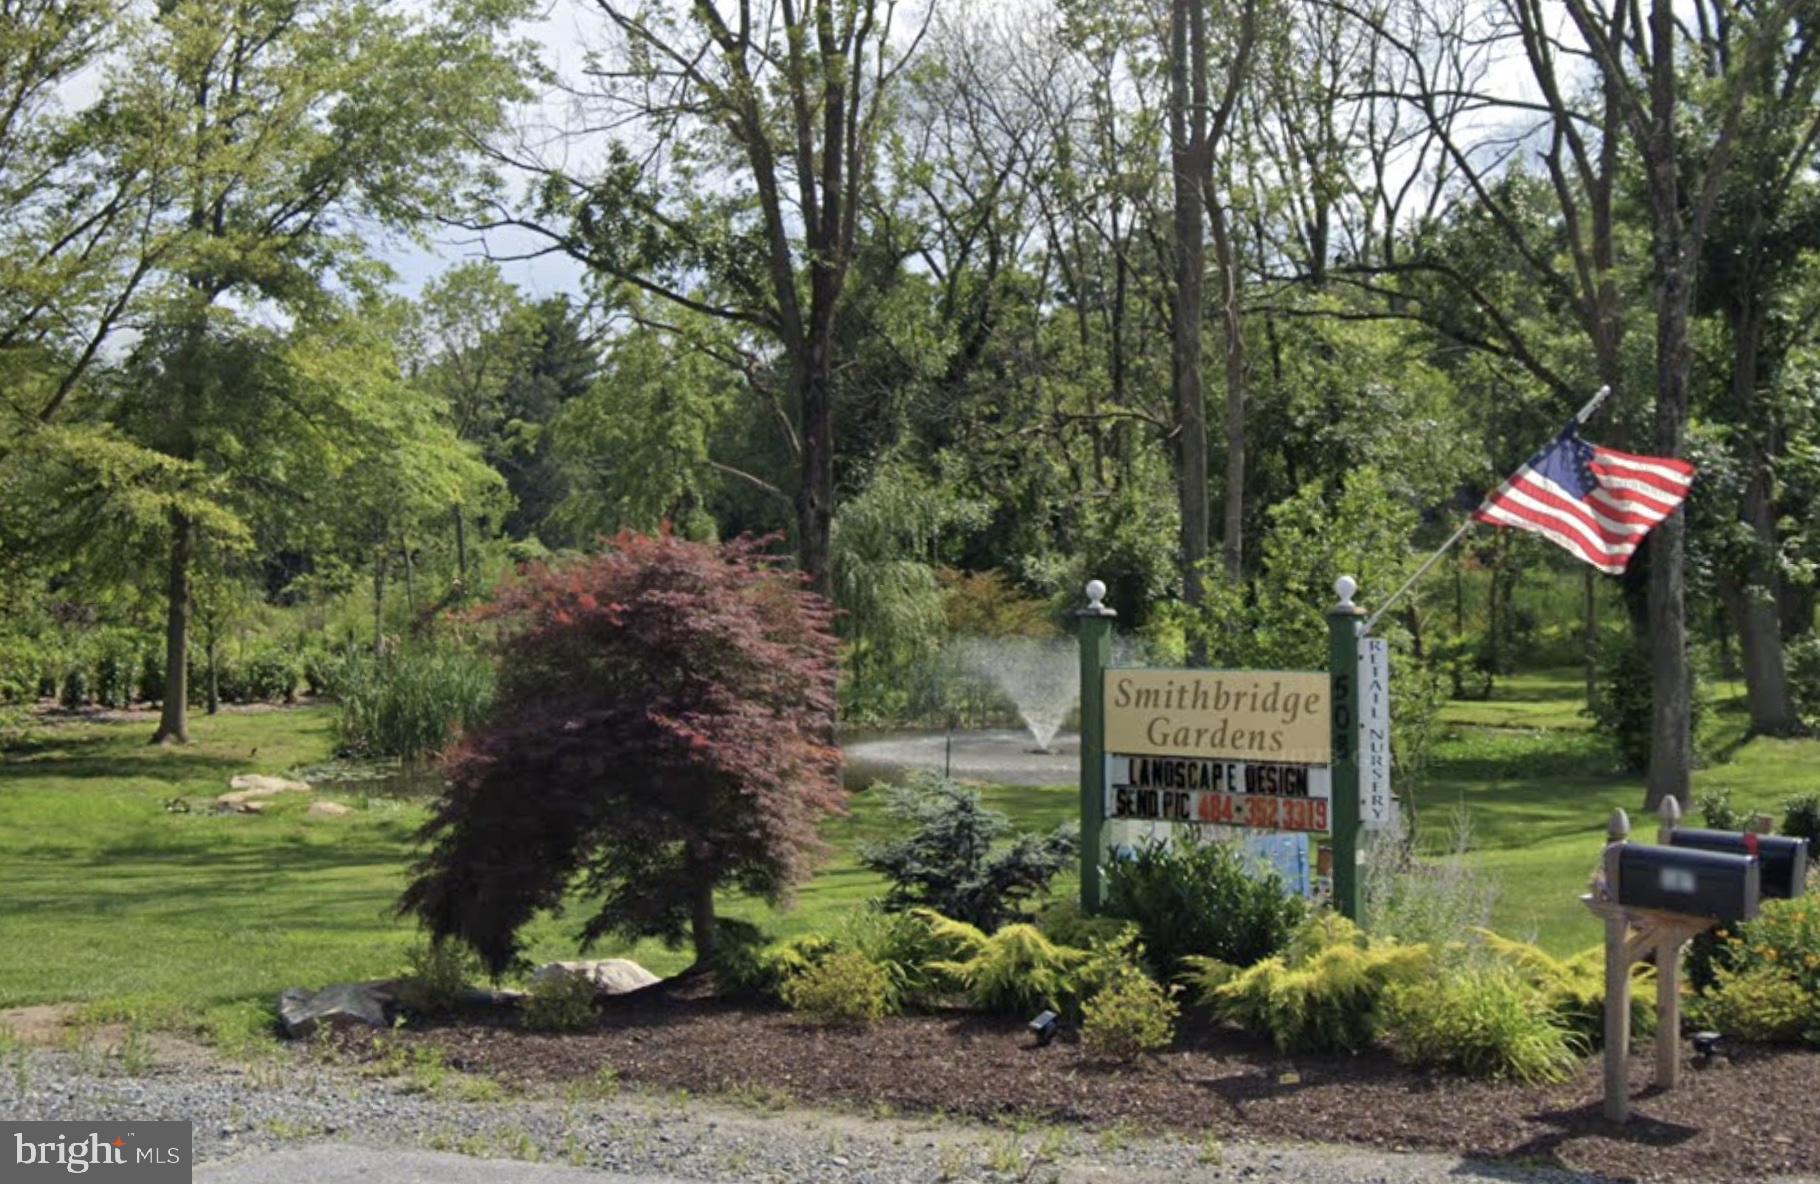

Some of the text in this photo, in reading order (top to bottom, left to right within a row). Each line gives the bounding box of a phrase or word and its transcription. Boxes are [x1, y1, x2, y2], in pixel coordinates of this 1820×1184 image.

[1114, 677, 1321, 725] Smithbridge
[1146, 716, 1284, 752] Gardens
[1368, 640, 1384, 820] RETAIL NURSERY
[1128, 758, 1237, 792] LANDSCAPE
[1244, 768, 1308, 797] DESIGN
[1115, 788, 1158, 818] SEND
[1163, 791, 1190, 819] PIC
